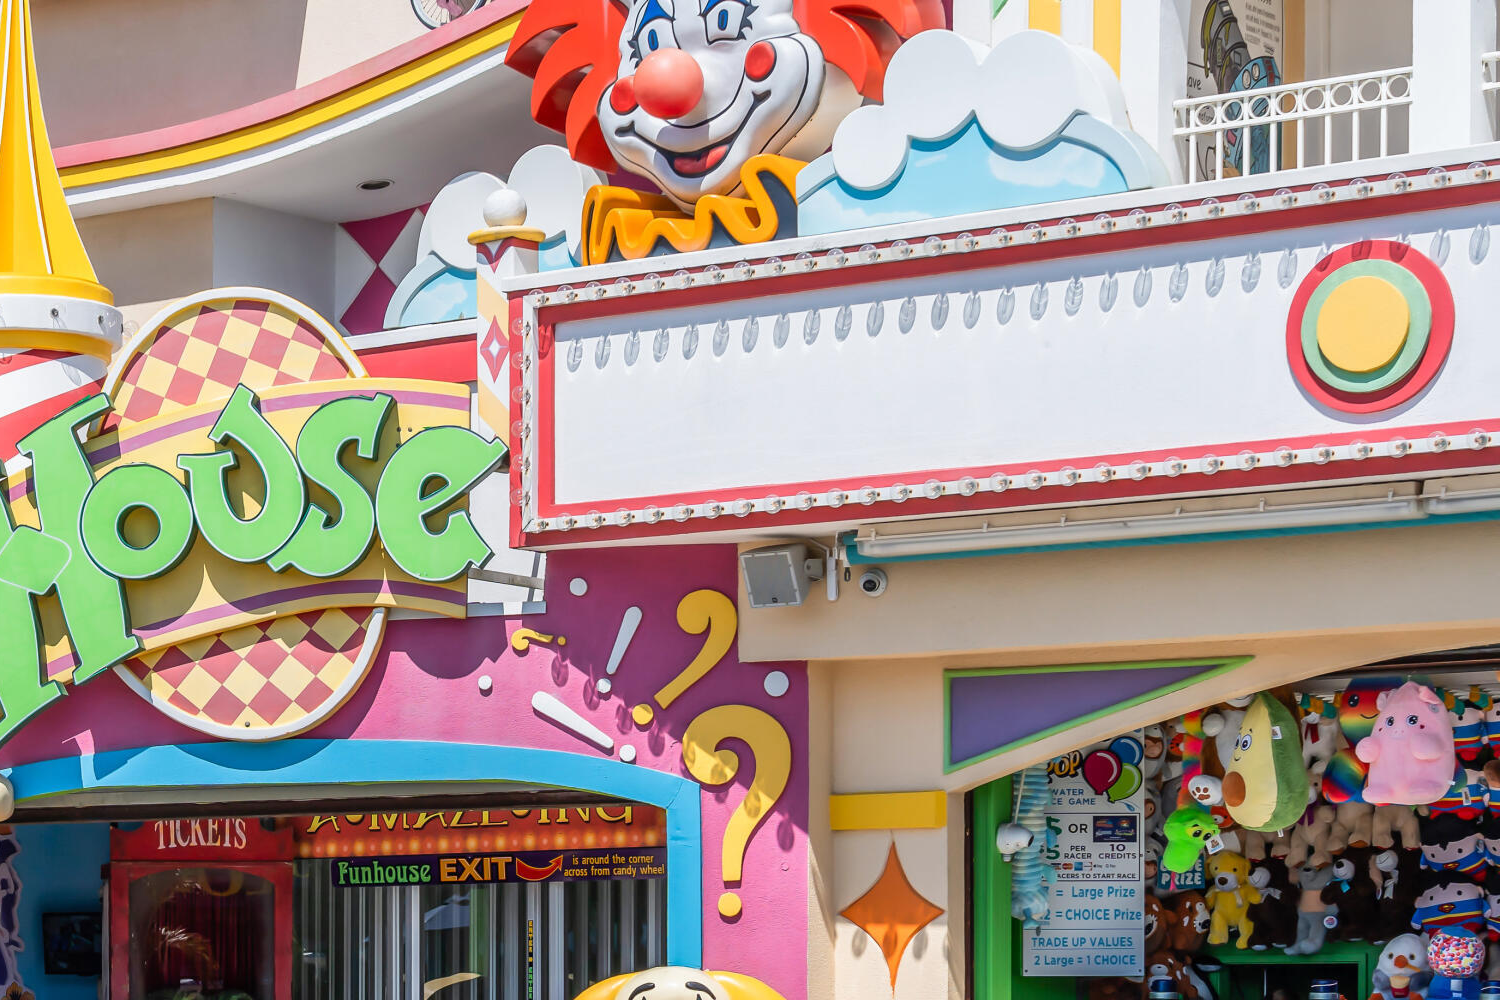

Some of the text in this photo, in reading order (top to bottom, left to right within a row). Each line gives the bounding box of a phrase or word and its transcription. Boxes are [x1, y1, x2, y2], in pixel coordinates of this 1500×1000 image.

[155, 818, 247, 850] TICKETS
[1068, 823, 1088, 834] OR
[1110, 844, 1126, 852] 10
[572, 854, 654, 865] is around the corner
[1064, 852, 1092, 860] RACER
[1098, 852, 1137, 860] CREDITS
[337, 856, 513, 886] Funhouse EXIT
[564, 864, 665, 879] across from candy wheel
[1072, 886, 1105, 900] Large
[1107, 886, 1136, 898] Prize
[1066, 909, 1111, 921] CHOICE
[1114, 909, 1142, 921] Prize
[1032, 936, 1133, 948] TRADE UP VALUES
[1034, 956, 1040, 965] 2
[1044, 955, 1074, 968] Large
[1094, 955, 1136, 965] CHOICE
